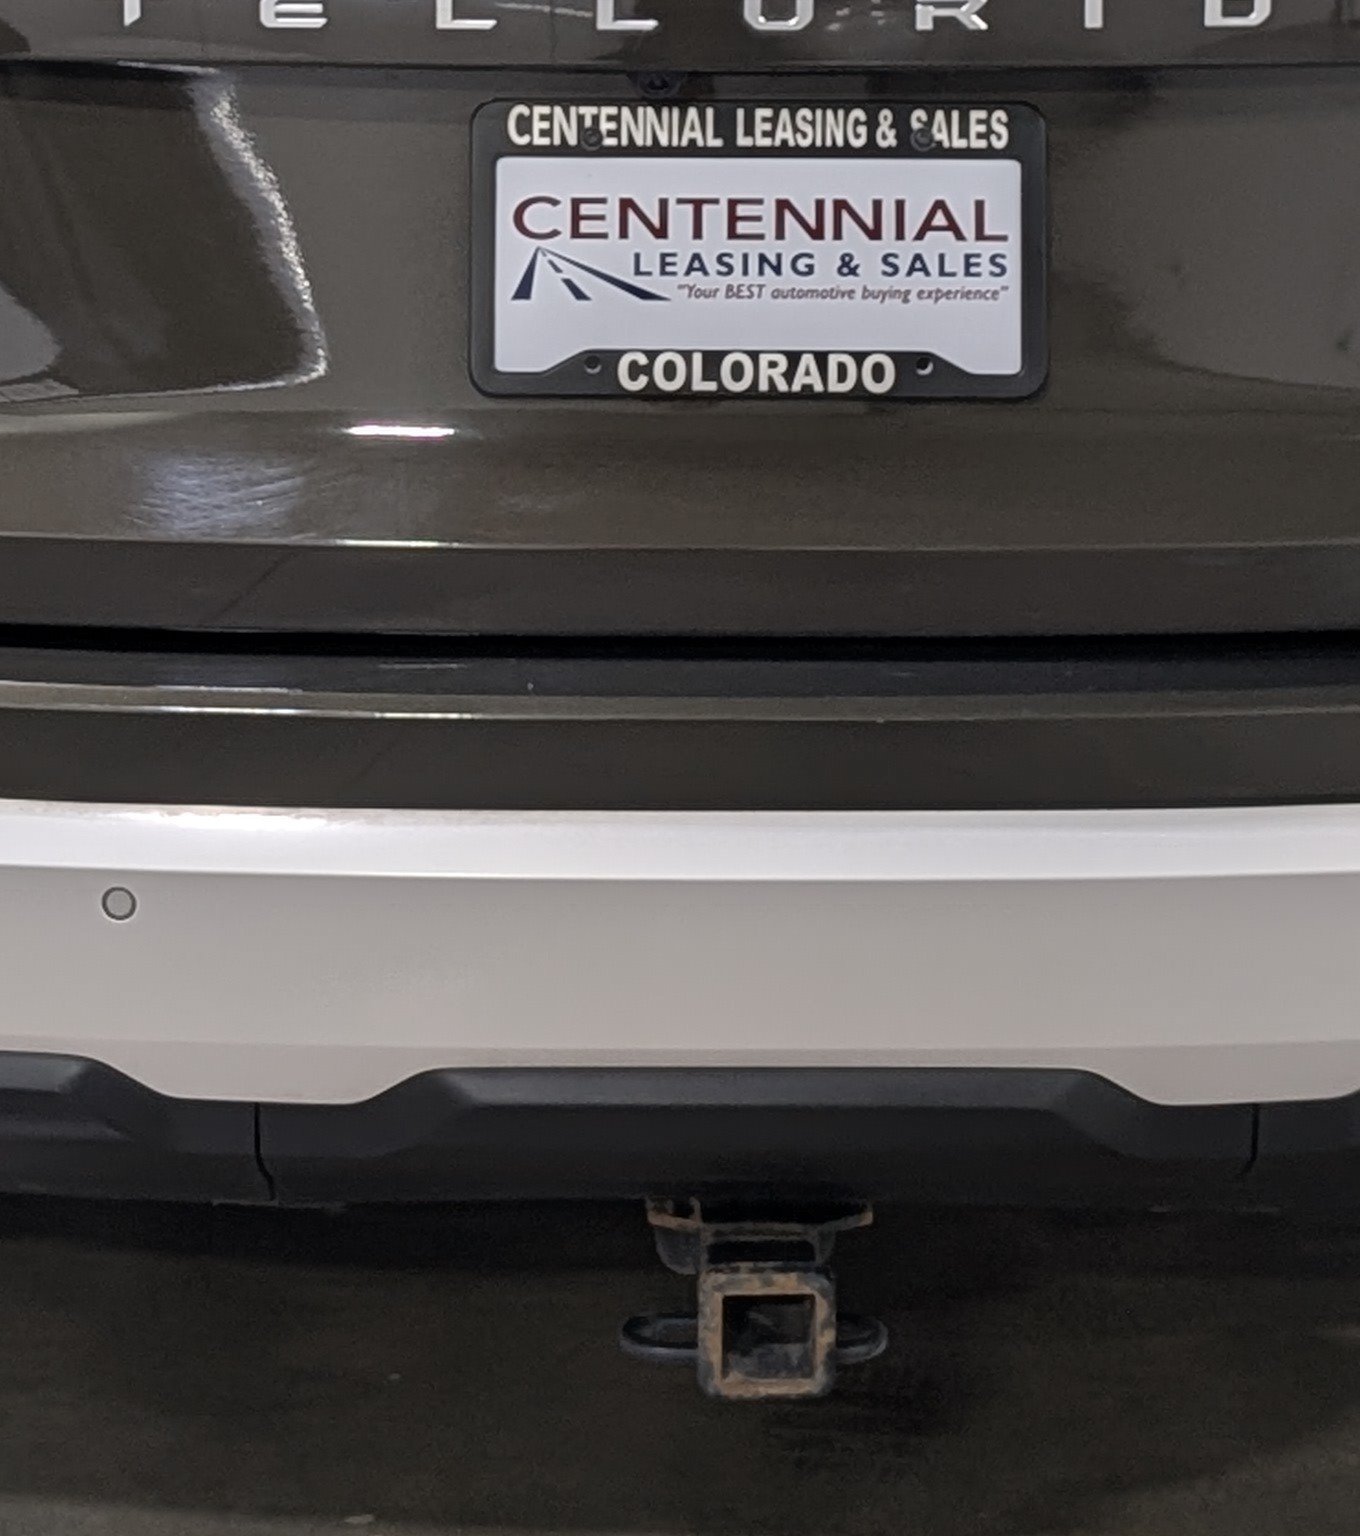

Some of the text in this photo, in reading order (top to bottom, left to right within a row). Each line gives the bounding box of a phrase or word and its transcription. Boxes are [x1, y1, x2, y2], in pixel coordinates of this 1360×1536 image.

[507, 104, 724, 148] CENTENNIAL
[736, 107, 868, 148] LEASING
[875, 108, 898, 148] &
[512, 195, 1009, 242] CENTENNIAL
[633, 252, 1009, 278] LEASING & SALES
[723, 284, 766, 300] BEST
[770, 284, 856, 301] automotive
[861, 283, 911, 304] buying
[616, 351, 896, 395] COLORADO
